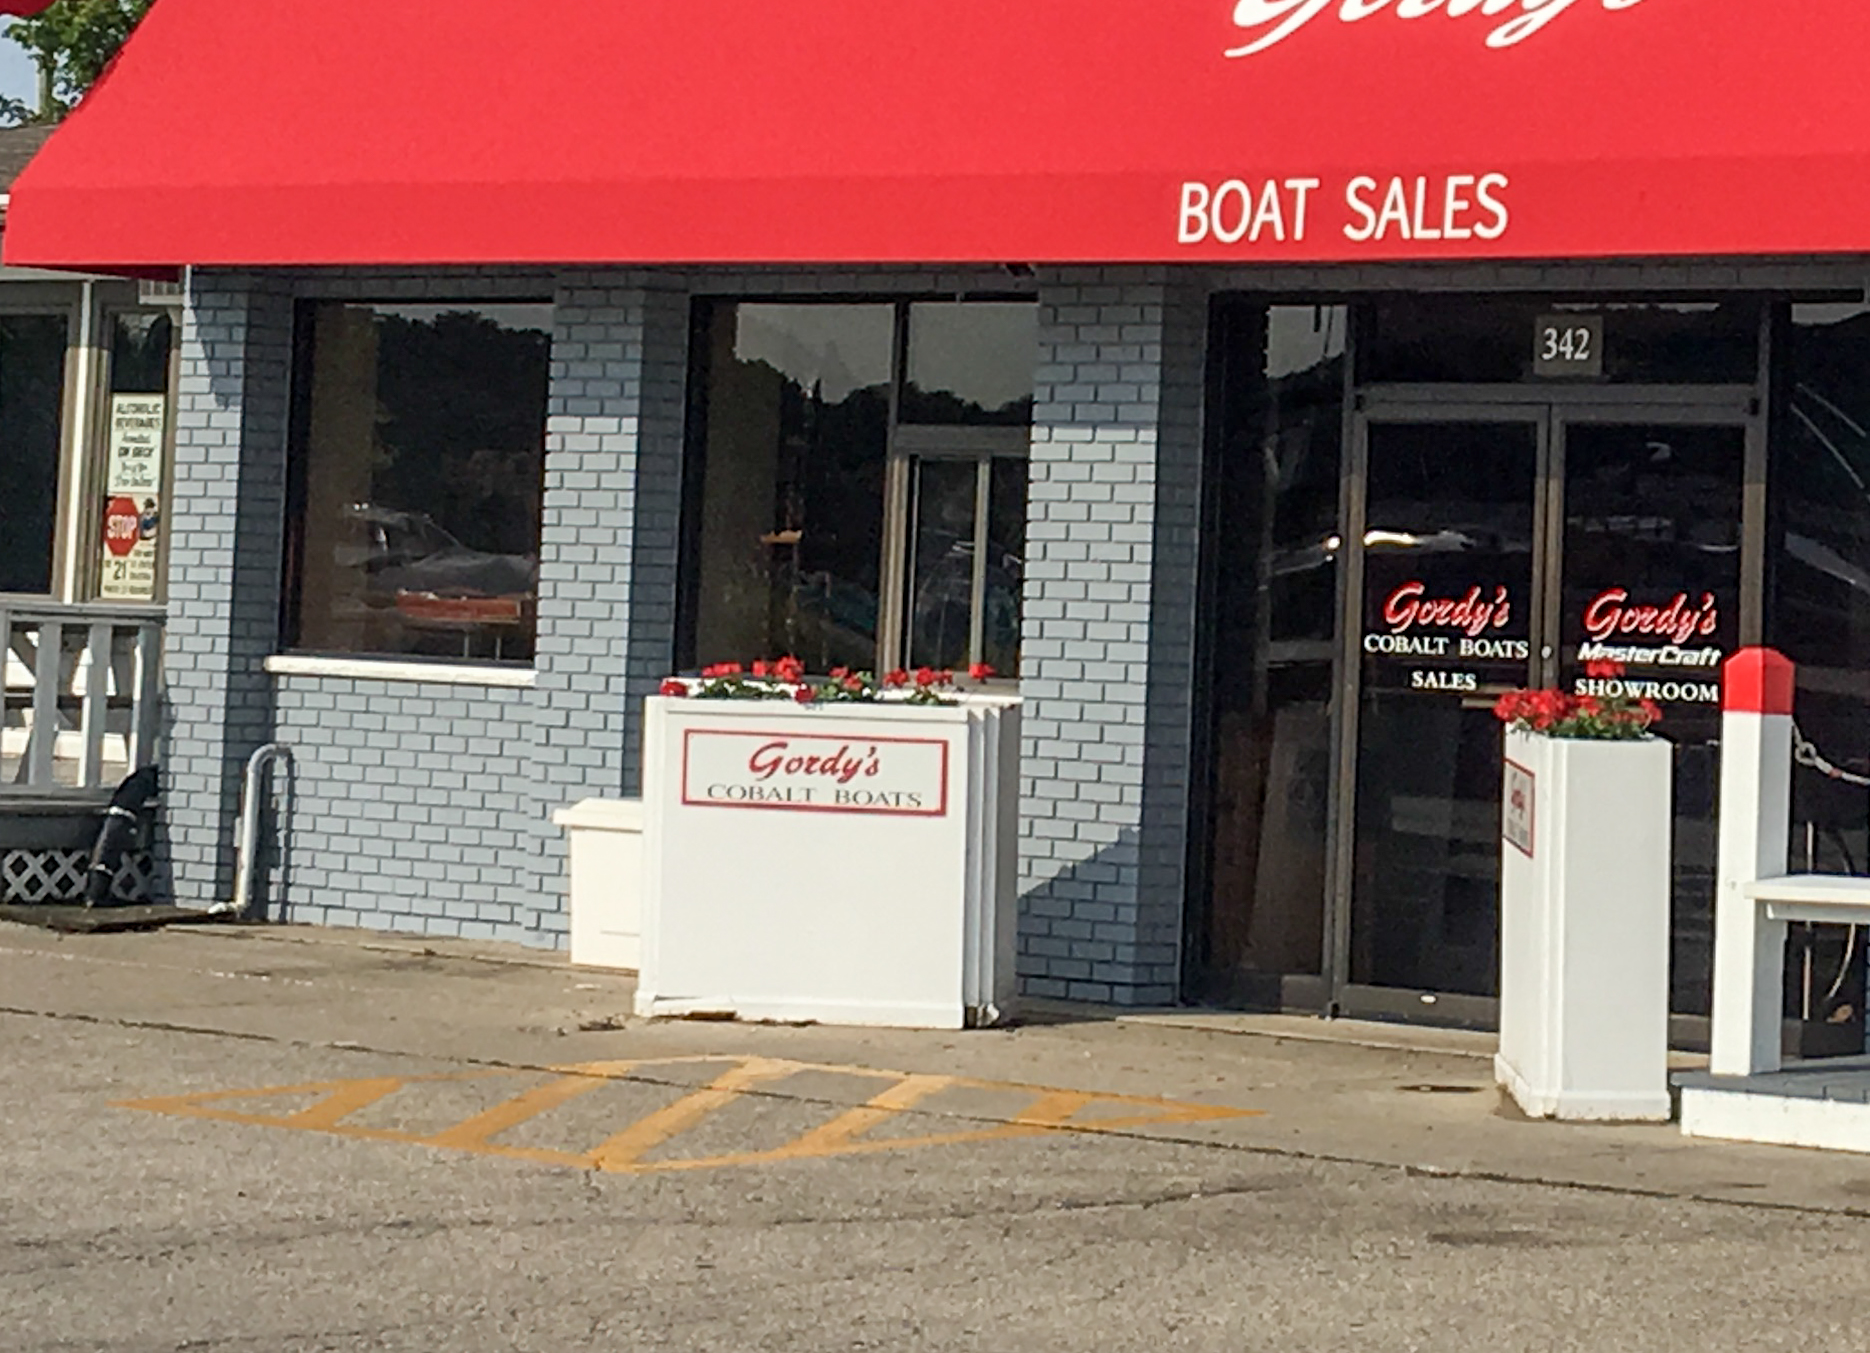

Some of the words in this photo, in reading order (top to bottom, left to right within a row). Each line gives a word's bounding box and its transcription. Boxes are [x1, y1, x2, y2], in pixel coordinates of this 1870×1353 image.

[1177, 178, 1320, 243] BOAT
[1342, 173, 1509, 240] SALES
[1540, 327, 1591, 361] 342
[107, 514, 138, 540] STOP
[1383, 581, 1511, 637] Gordy's
[1584, 587, 1718, 644] Gordy's
[1364, 633, 1449, 656] COBALT
[1459, 637, 1529, 659] BOATS
[1577, 642, 1722, 667] MasterCraft
[1411, 670, 1477, 691] SALES
[1574, 678, 1719, 703] SHOWROOM
[748, 741, 880, 784] Gordy's
[706, 783, 817, 803] COBALT
[833, 788, 922, 808] BOATS
